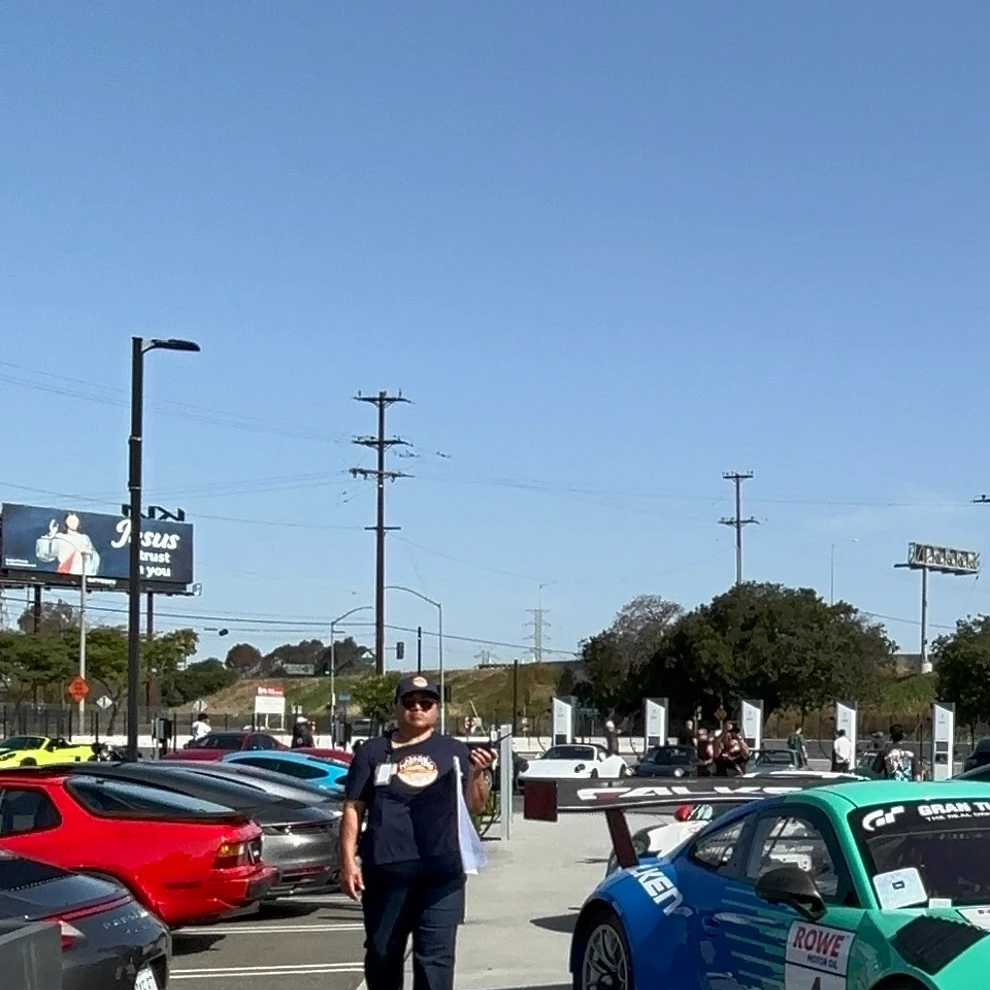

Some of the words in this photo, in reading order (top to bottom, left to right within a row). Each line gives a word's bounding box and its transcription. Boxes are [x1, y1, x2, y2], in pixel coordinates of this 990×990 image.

[111, 518, 180, 549] Jsus
[146, 566, 171, 578] you
[918, 802, 970, 817] GRAN
[792, 925, 845, 958] ROWE
